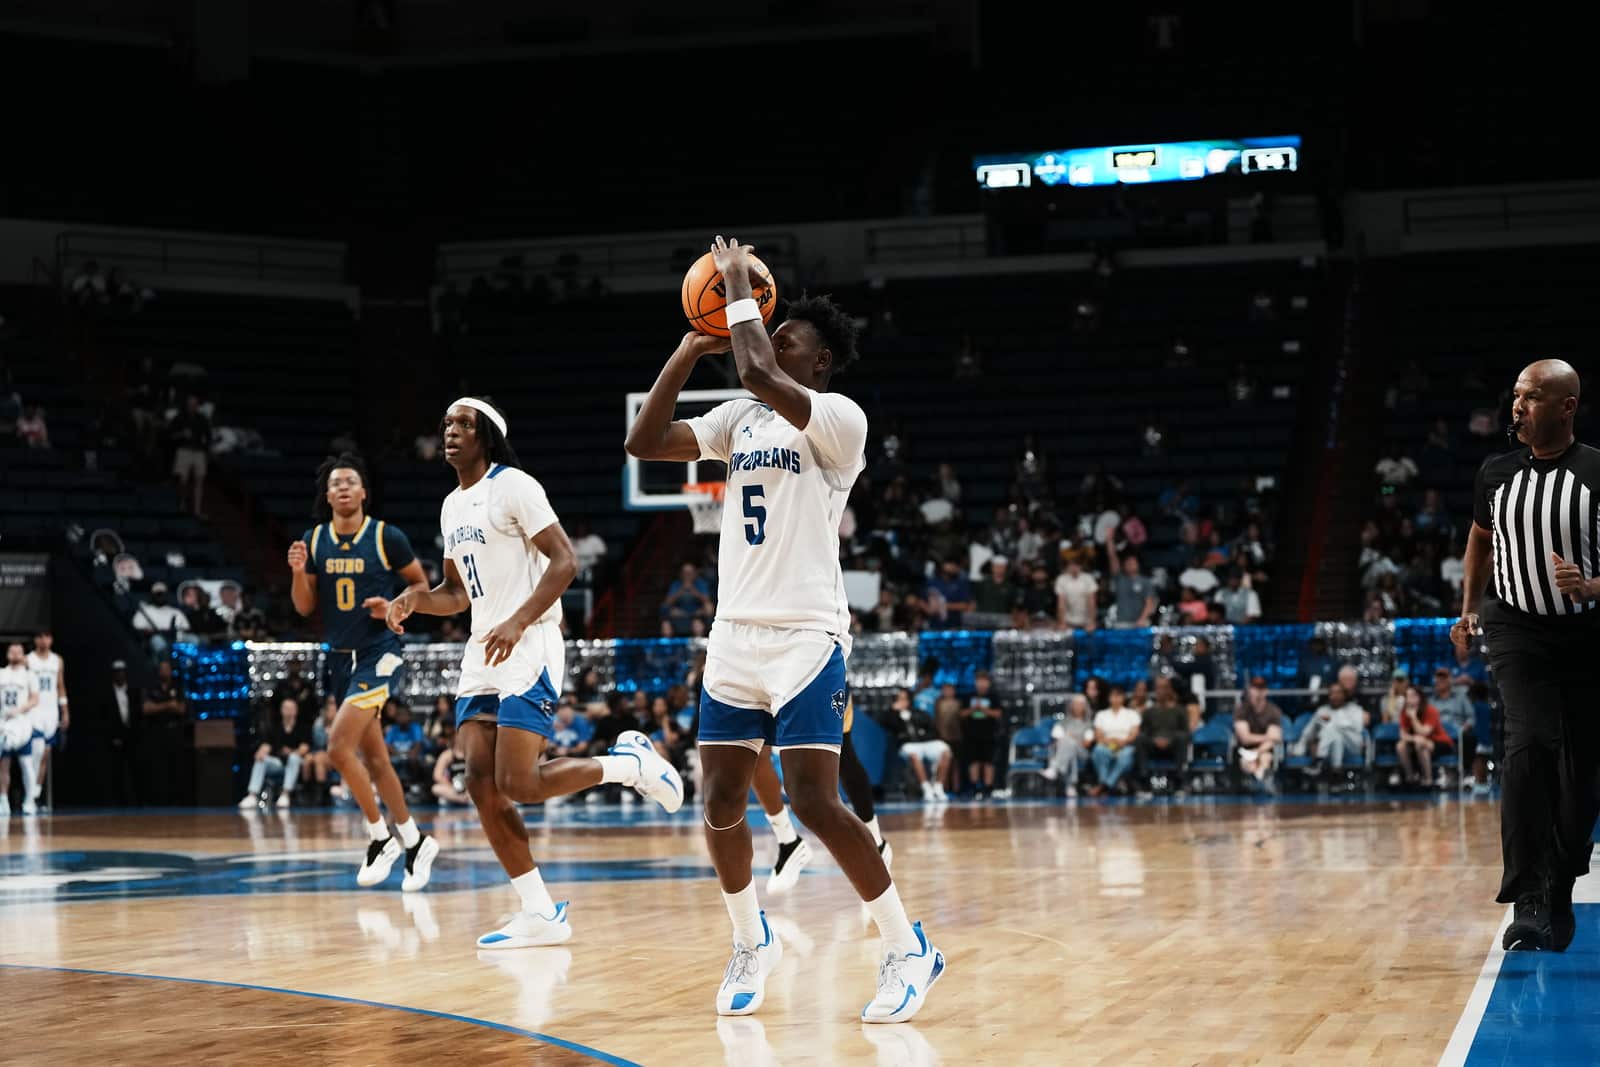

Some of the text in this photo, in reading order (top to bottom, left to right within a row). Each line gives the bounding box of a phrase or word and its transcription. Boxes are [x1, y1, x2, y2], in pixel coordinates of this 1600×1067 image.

[742, 484, 767, 545] 5
[335, 577, 355, 612] 0
[462, 553, 485, 599] 21
